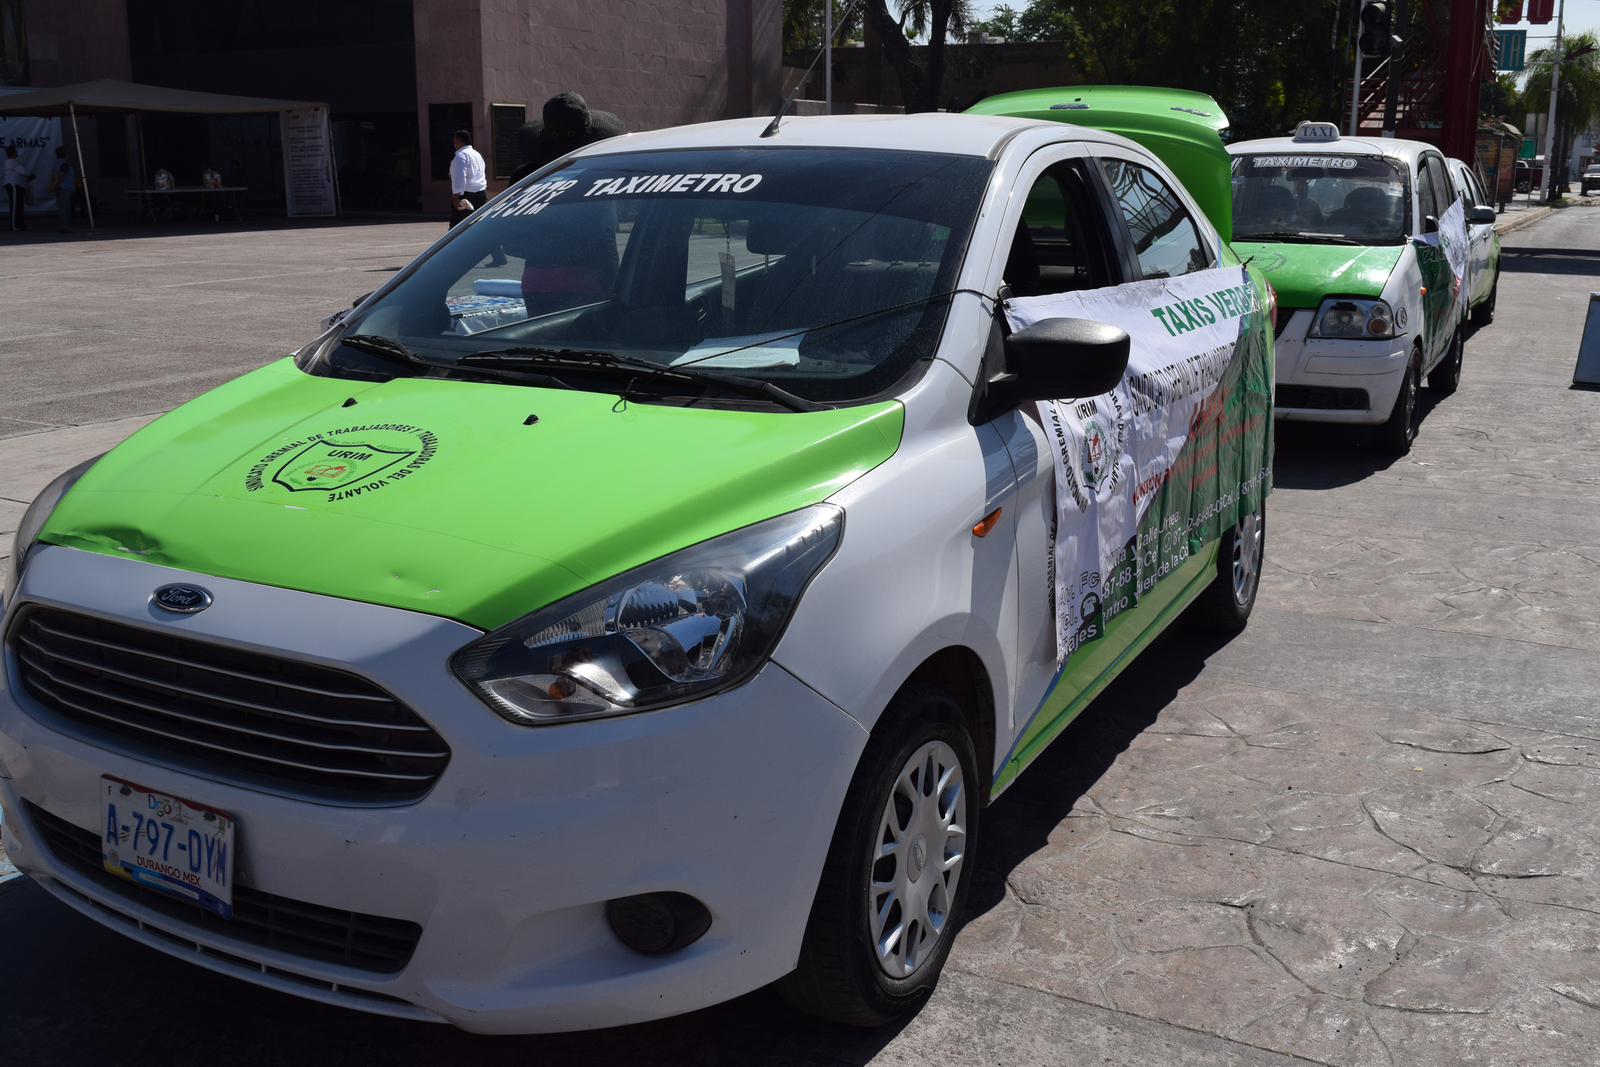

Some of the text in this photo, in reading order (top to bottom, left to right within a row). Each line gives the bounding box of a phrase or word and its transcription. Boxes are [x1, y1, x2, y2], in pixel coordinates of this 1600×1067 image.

[1302, 127, 1334, 137] TAXI
[1253, 157, 1357, 169] TAXIMETRO
[583, 173, 763, 197] TAXIMETRO
[1151, 298, 1217, 337] TAXIS
[1075, 400, 1098, 420] URIM
[307, 433, 324, 442] DE
[327, 423, 416, 437] TRABAJADORES
[1050, 409, 1069, 466] GREMIAL
[260, 440, 307, 463] GREMIAL
[327, 449, 374, 461] URIM
[386, 469, 413, 480] DEL
[328, 480, 390, 503] VOLANTE
[1137, 526, 1159, 551] Calle
[1157, 559, 1170, 578] de
[1171, 553, 1180, 569] la
[161, 587, 197, 605] Ford
[148, 793, 173, 818] Dgo
[106, 803, 228, 888] A-797-DYM
[137, 855, 203, 888] DURANGO MEX.
